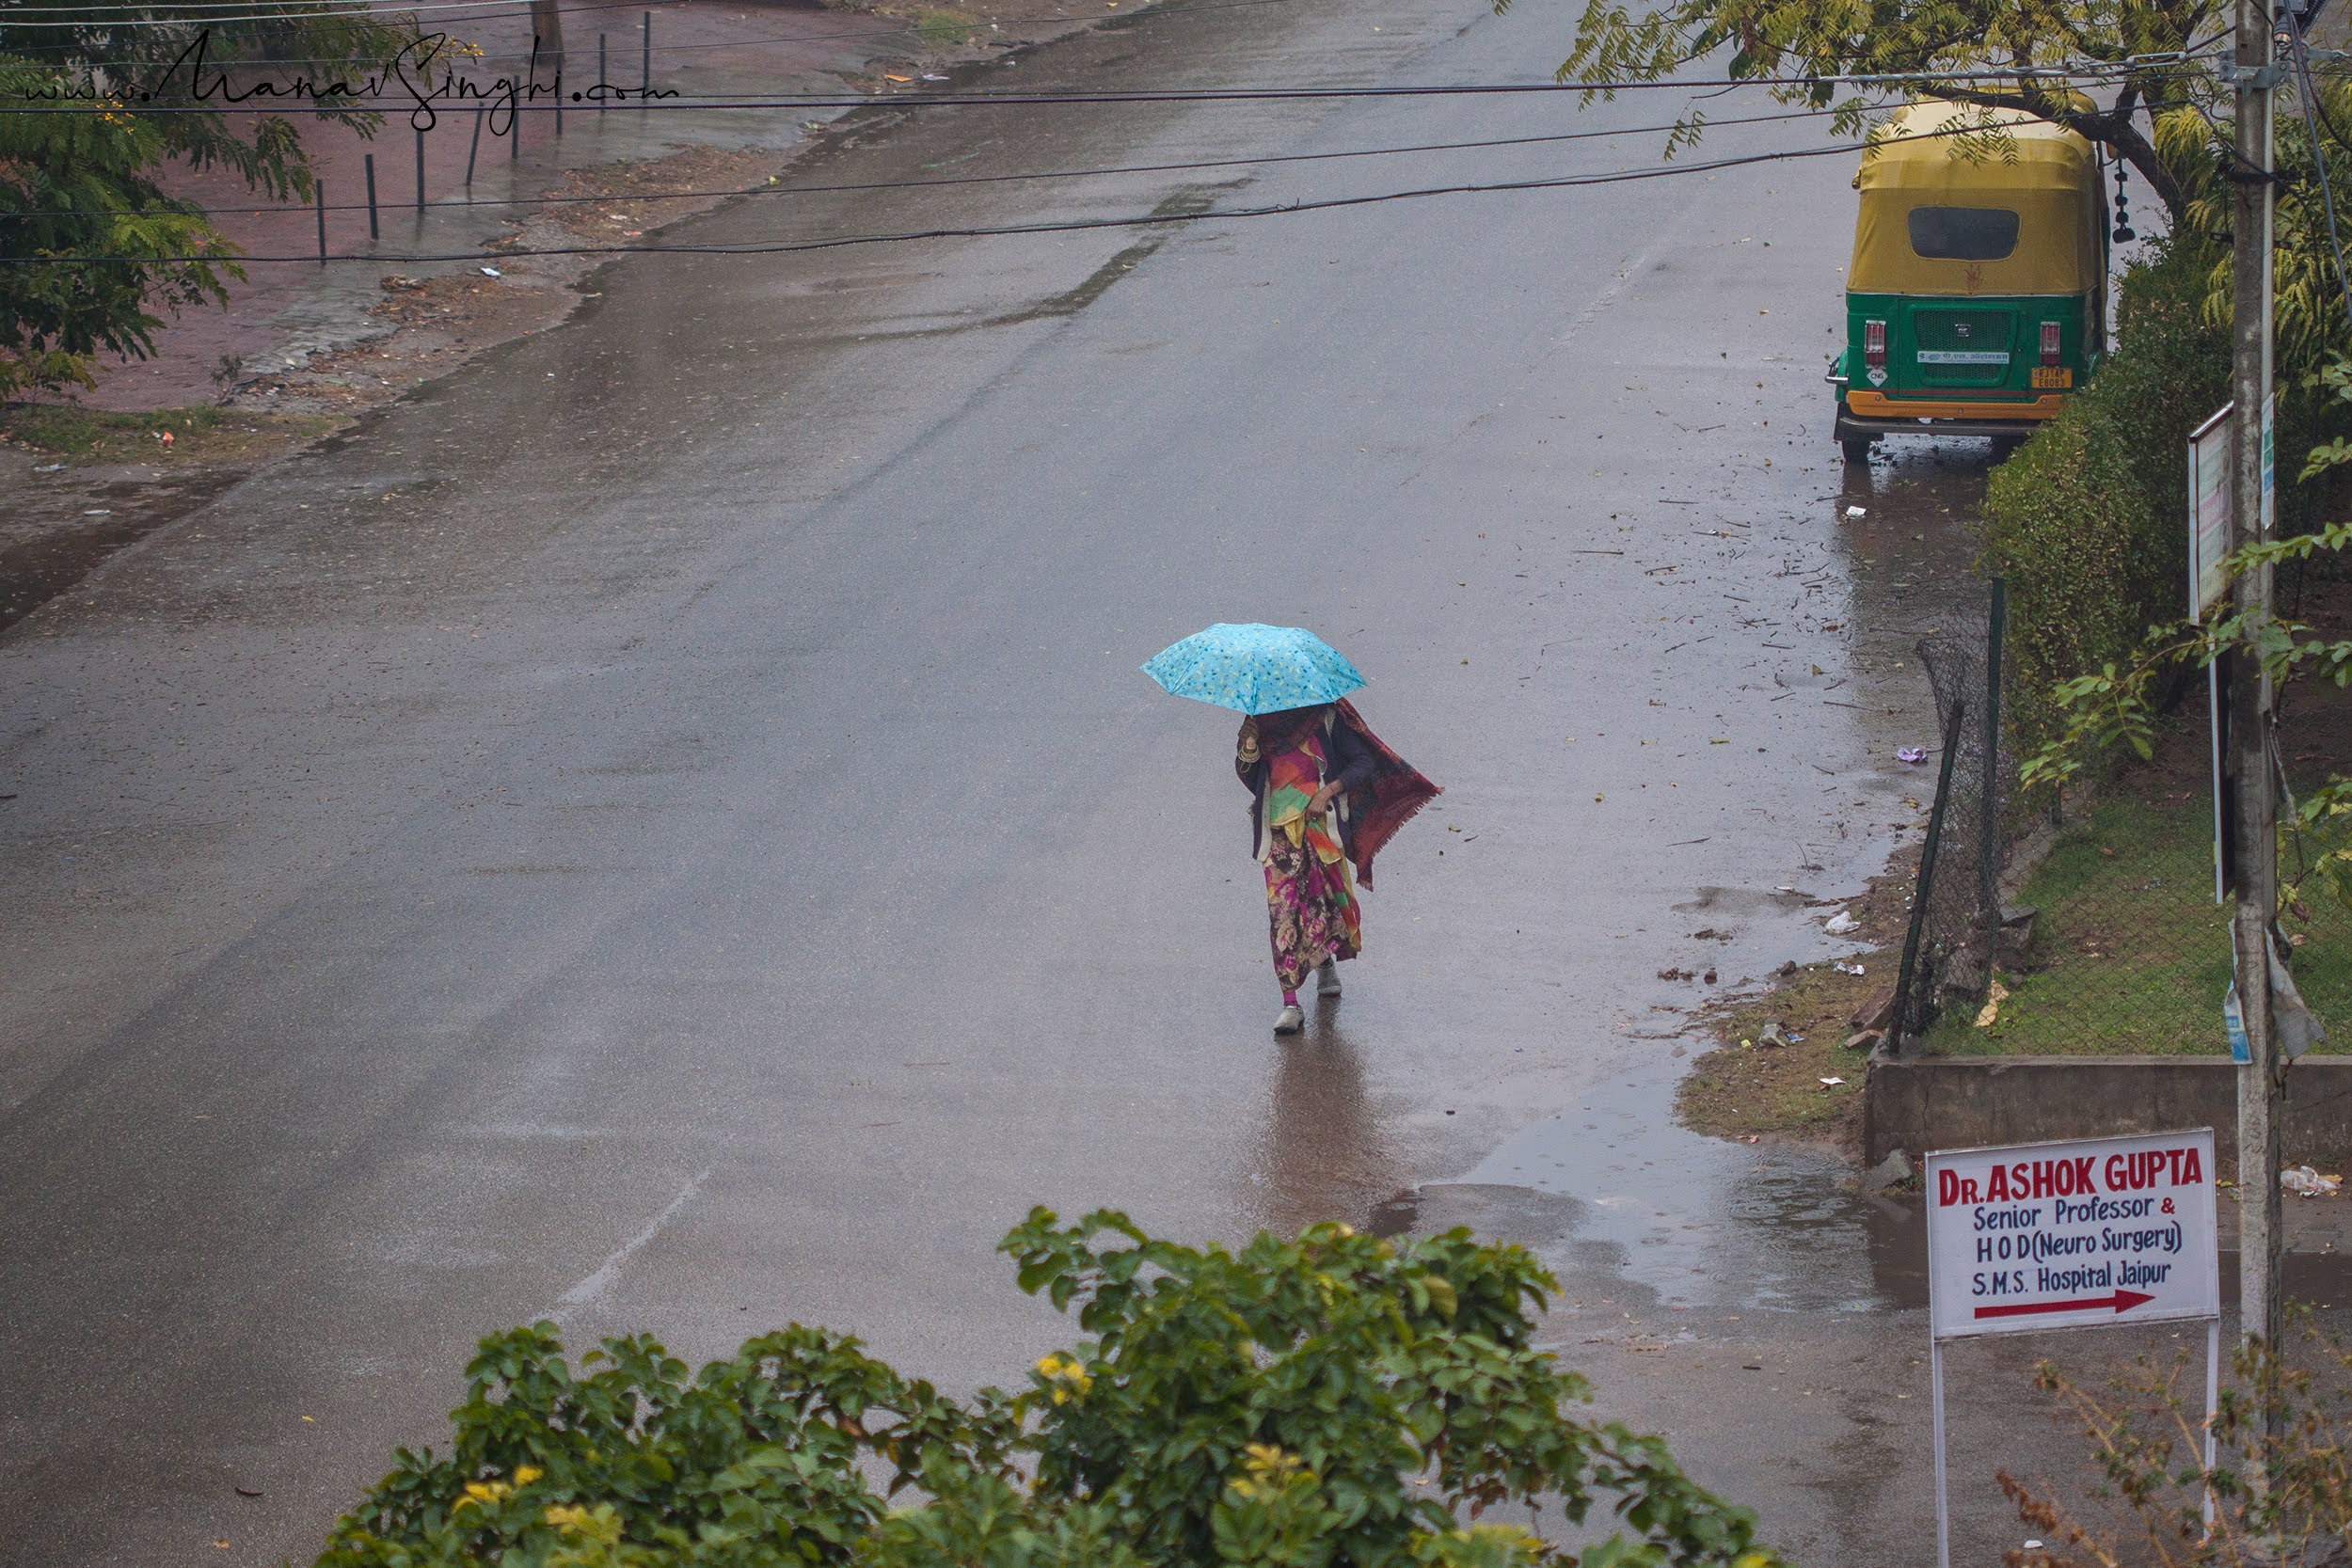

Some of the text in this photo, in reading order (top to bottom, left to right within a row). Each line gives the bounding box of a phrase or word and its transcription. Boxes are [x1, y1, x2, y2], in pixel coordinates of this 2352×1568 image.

[2039, 378, 2065, 388] E6083
[2105, 1148, 2203, 1193] GUPTA
[1973, 1196, 2176, 1232] Senior Professor &
[2101, 1219, 2183, 1257] Surgery)
[1972, 1259, 2172, 1296] S.M.S. Hospital Jaipur
